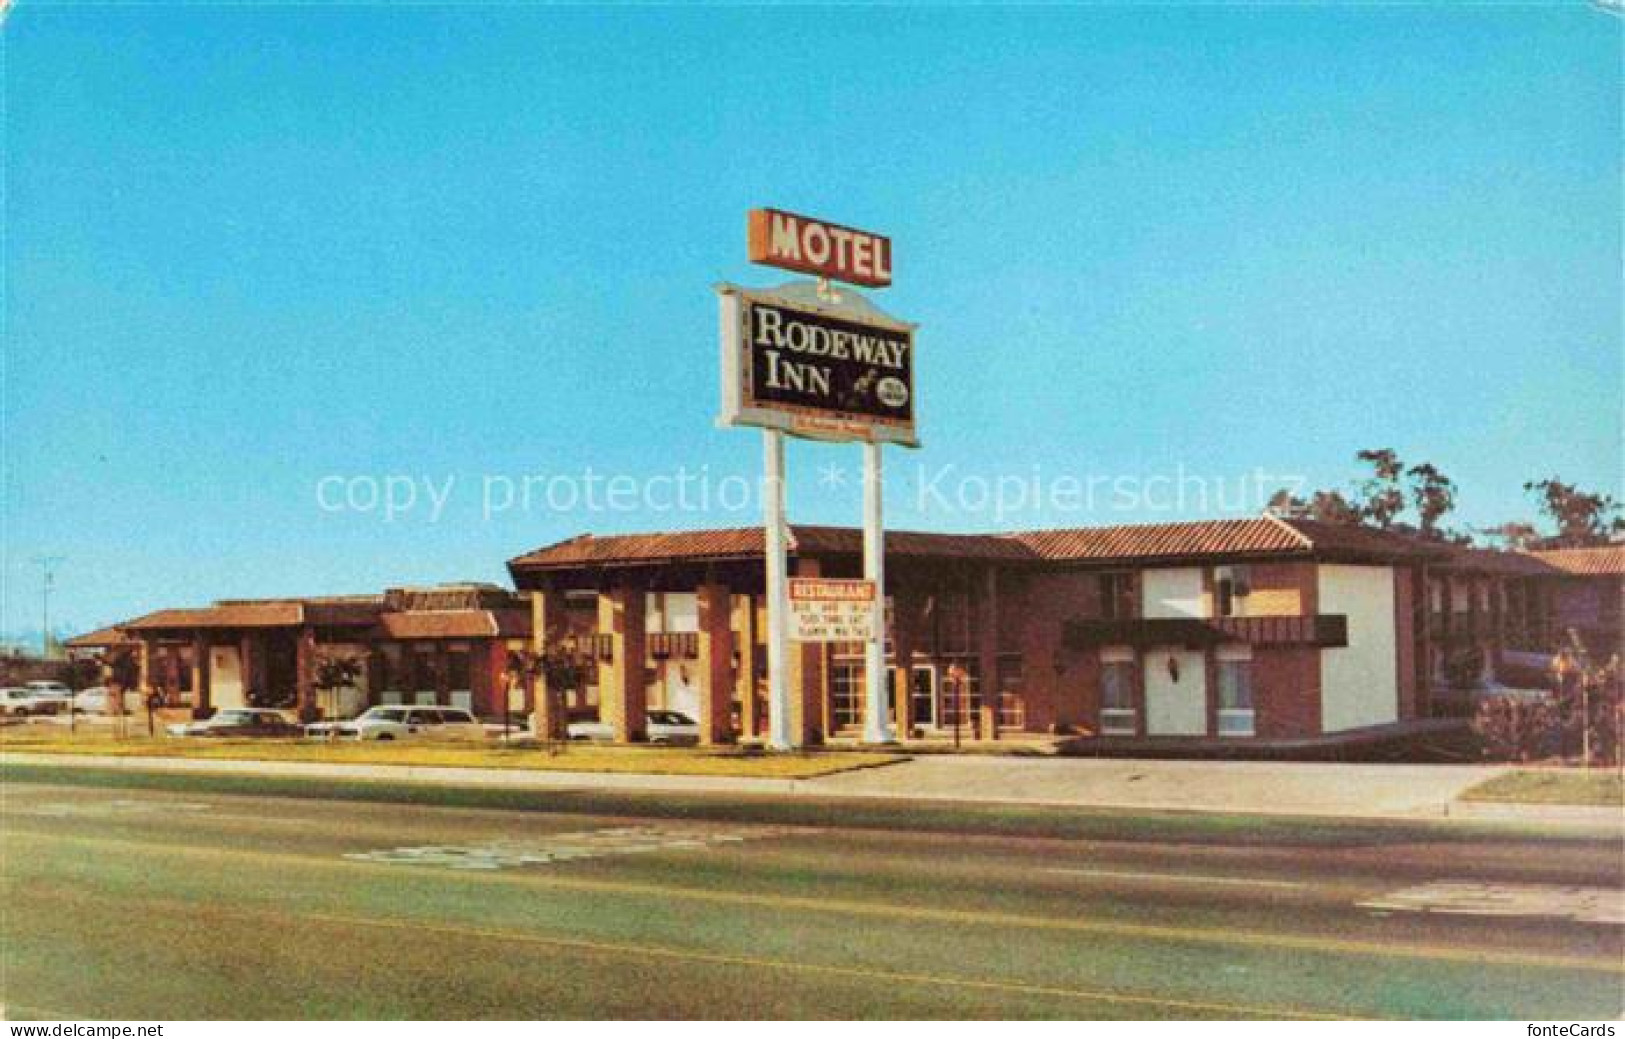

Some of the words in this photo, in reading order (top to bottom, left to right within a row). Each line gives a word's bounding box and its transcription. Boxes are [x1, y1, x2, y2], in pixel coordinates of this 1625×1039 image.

[772, 212, 891, 279] MOTEL
[754, 307, 907, 370] RODEWAY
[765, 350, 832, 396] INN
